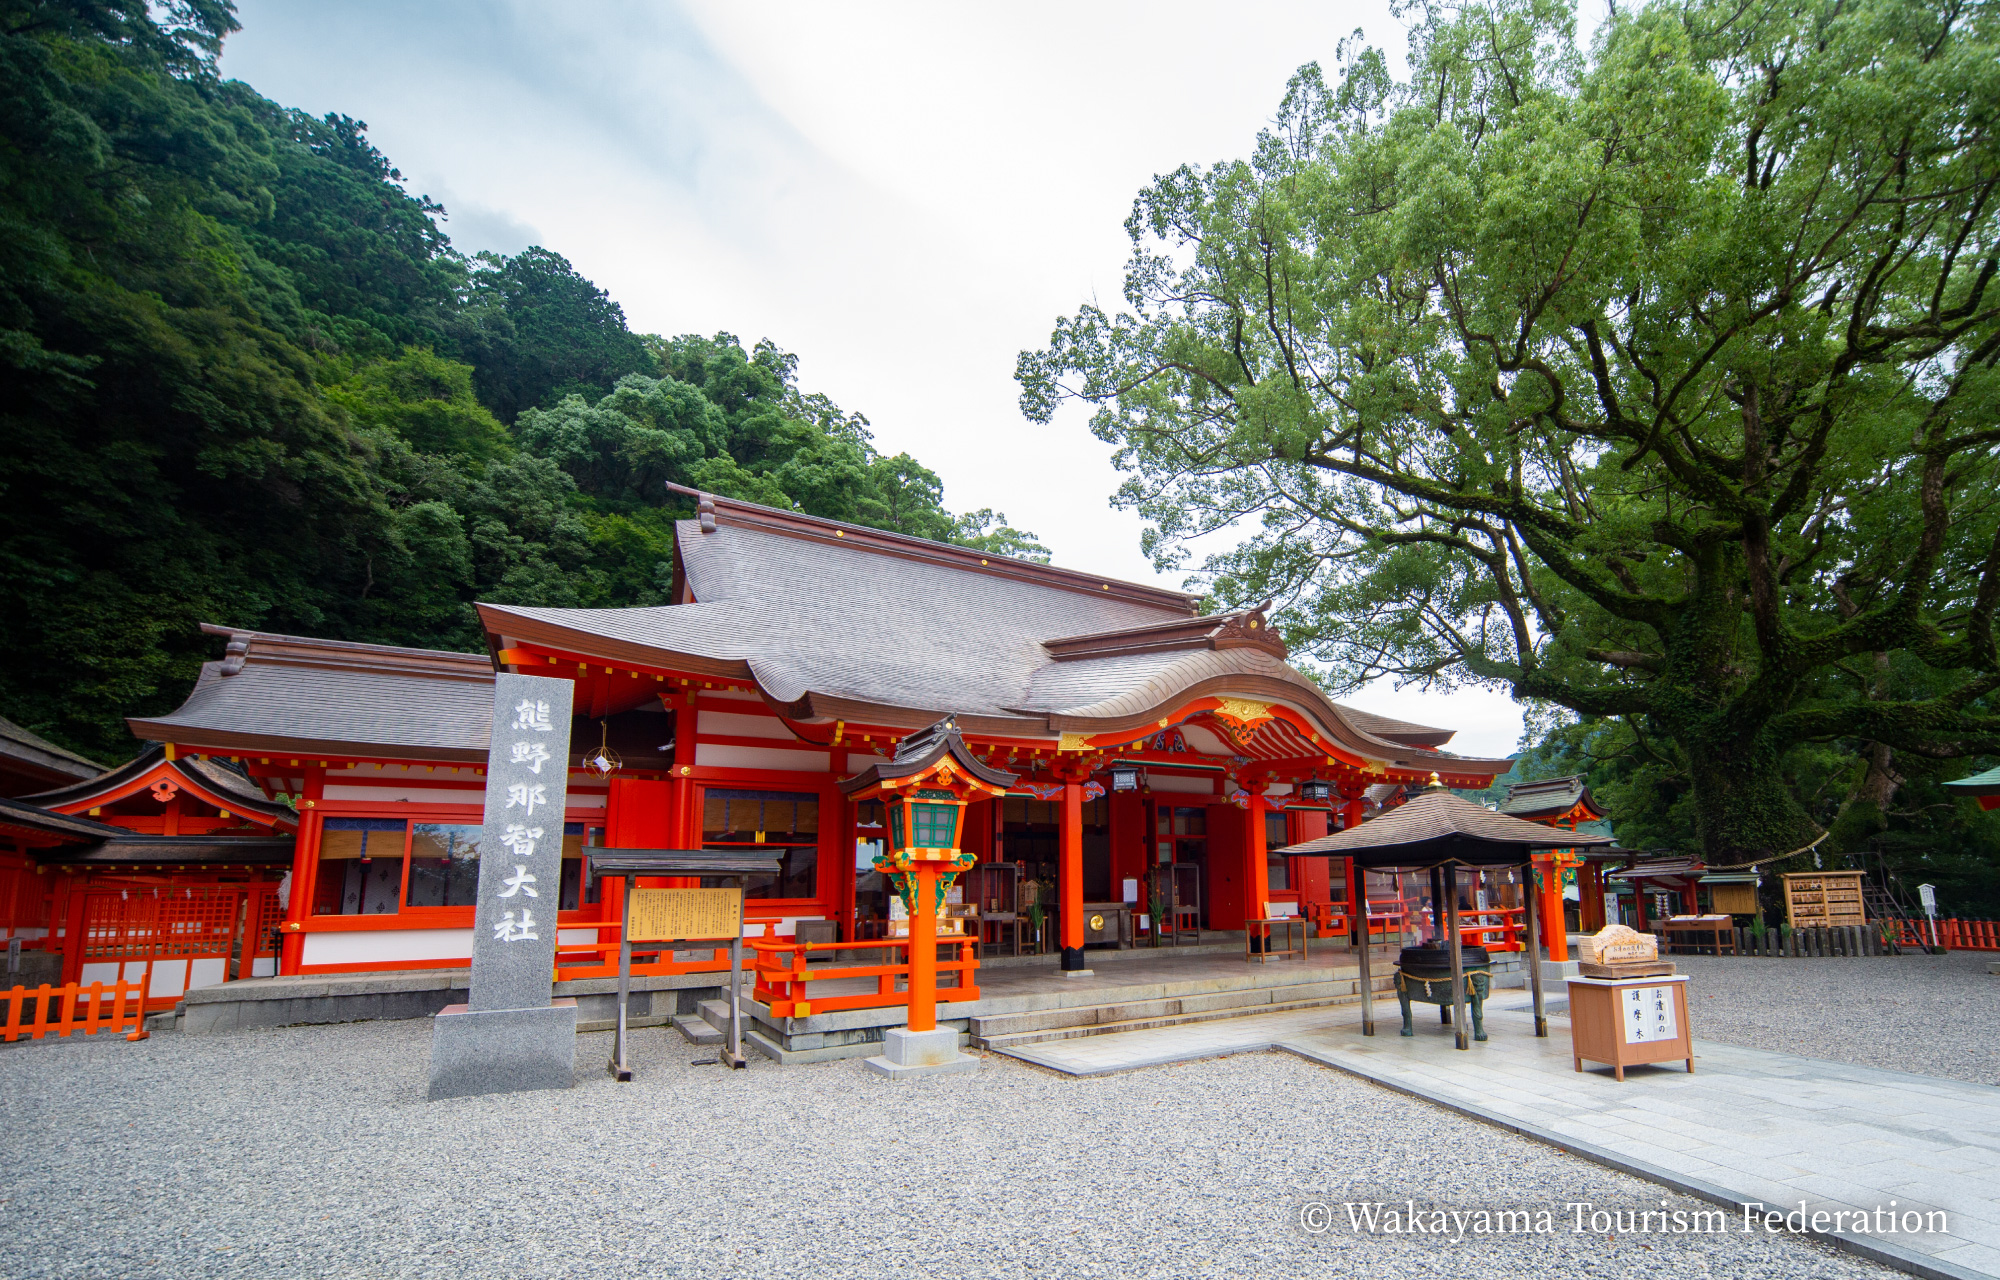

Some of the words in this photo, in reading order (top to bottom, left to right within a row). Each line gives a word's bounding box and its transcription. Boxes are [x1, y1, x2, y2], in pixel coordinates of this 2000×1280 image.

[493, 699, 553, 942] 熊野那智大社
[1631, 990, 1644, 1040] 護摩木
[1655, 989, 1665, 1033] お清めの
